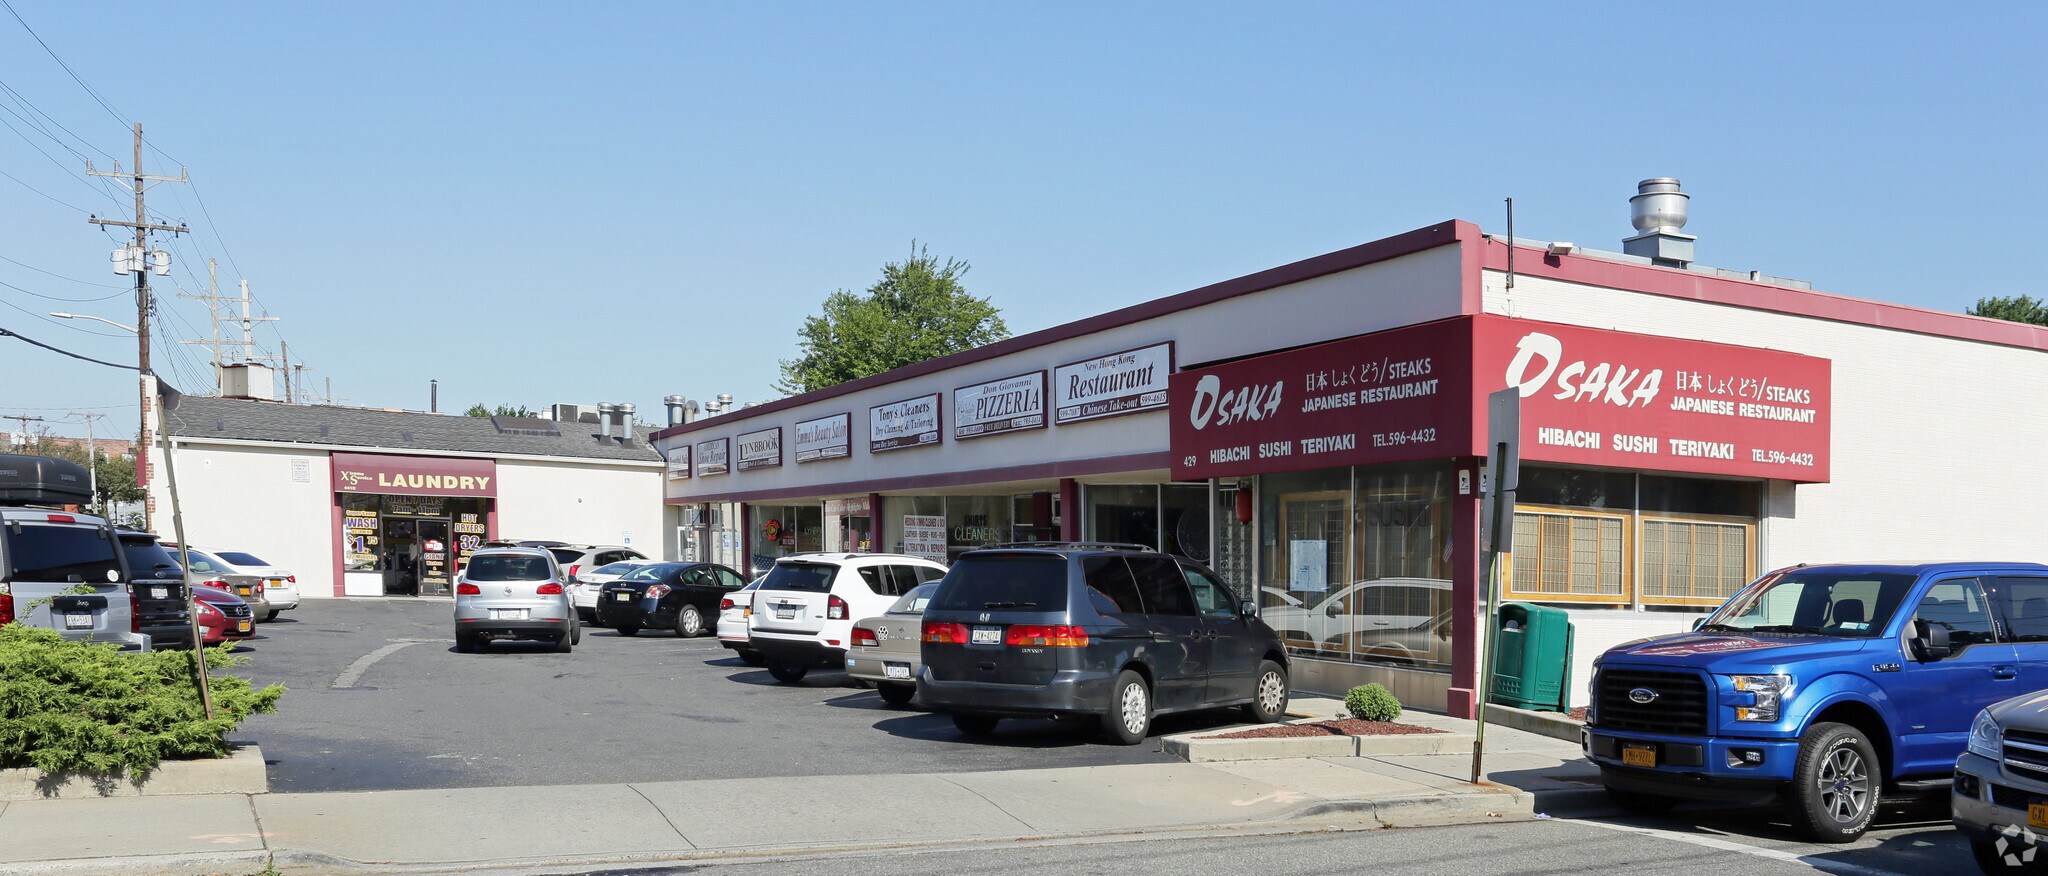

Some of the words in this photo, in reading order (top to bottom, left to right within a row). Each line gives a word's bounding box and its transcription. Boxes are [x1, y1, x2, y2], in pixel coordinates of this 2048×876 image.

[1084, 363, 1097, 372] New
[1099, 358, 1117, 369] Hong
[1118, 354, 1136, 365] Kong
[982, 385, 997, 395] Don
[999, 377, 1032, 391] Giovanni
[1068, 361, 1154, 400] Restaurant
[975, 387, 1040, 420] PIZZERIA
[1302, 391, 1356, 413] JAPANESE
[1360, 379, 1439, 404] RESTAURANT
[879, 406, 898, 422] Tony's
[901, 402, 930, 417] Cleaners
[1082, 404, 1107, 416] Chinese
[1109, 399, 1138, 412] Take-out
[1670, 396, 1735, 416] JAPANESE
[1739, 402, 1816, 424] RESTAURANT
[875, 426, 884, 437] Dry
[884, 424, 904, 435] Cleaning
[905, 421, 909, 430] &
[911, 417, 934, 429] Tailoring
[739, 437, 779, 461] LYNBROOK
[1183, 455, 1197, 467] 429
[1210, 446, 1250, 464] HIBACHI
[1259, 441, 1292, 459] SUSHI
[1301, 433, 1356, 454] TERIYAKI
[1372, 428, 1436, 447] TEL.596-4432
[1538, 427, 1601, 449] HIBACHI
[1613, 433, 1658, 454] SUSHI
[1669, 438, 1735, 460] TERIYAKI
[1752, 448, 1814, 466] TEL.596-4432
[378, 473, 490, 490] LAUNDRY
[389, 495, 411, 504] OPEN
[420, 496, 443, 505] DAYS
[346, 517, 378, 529] WASH
[461, 513, 478, 523] HOT
[454, 522, 485, 533] DRYERS
[954, 526, 999, 542] CLEANERS
[460, 535, 480, 550] 32
